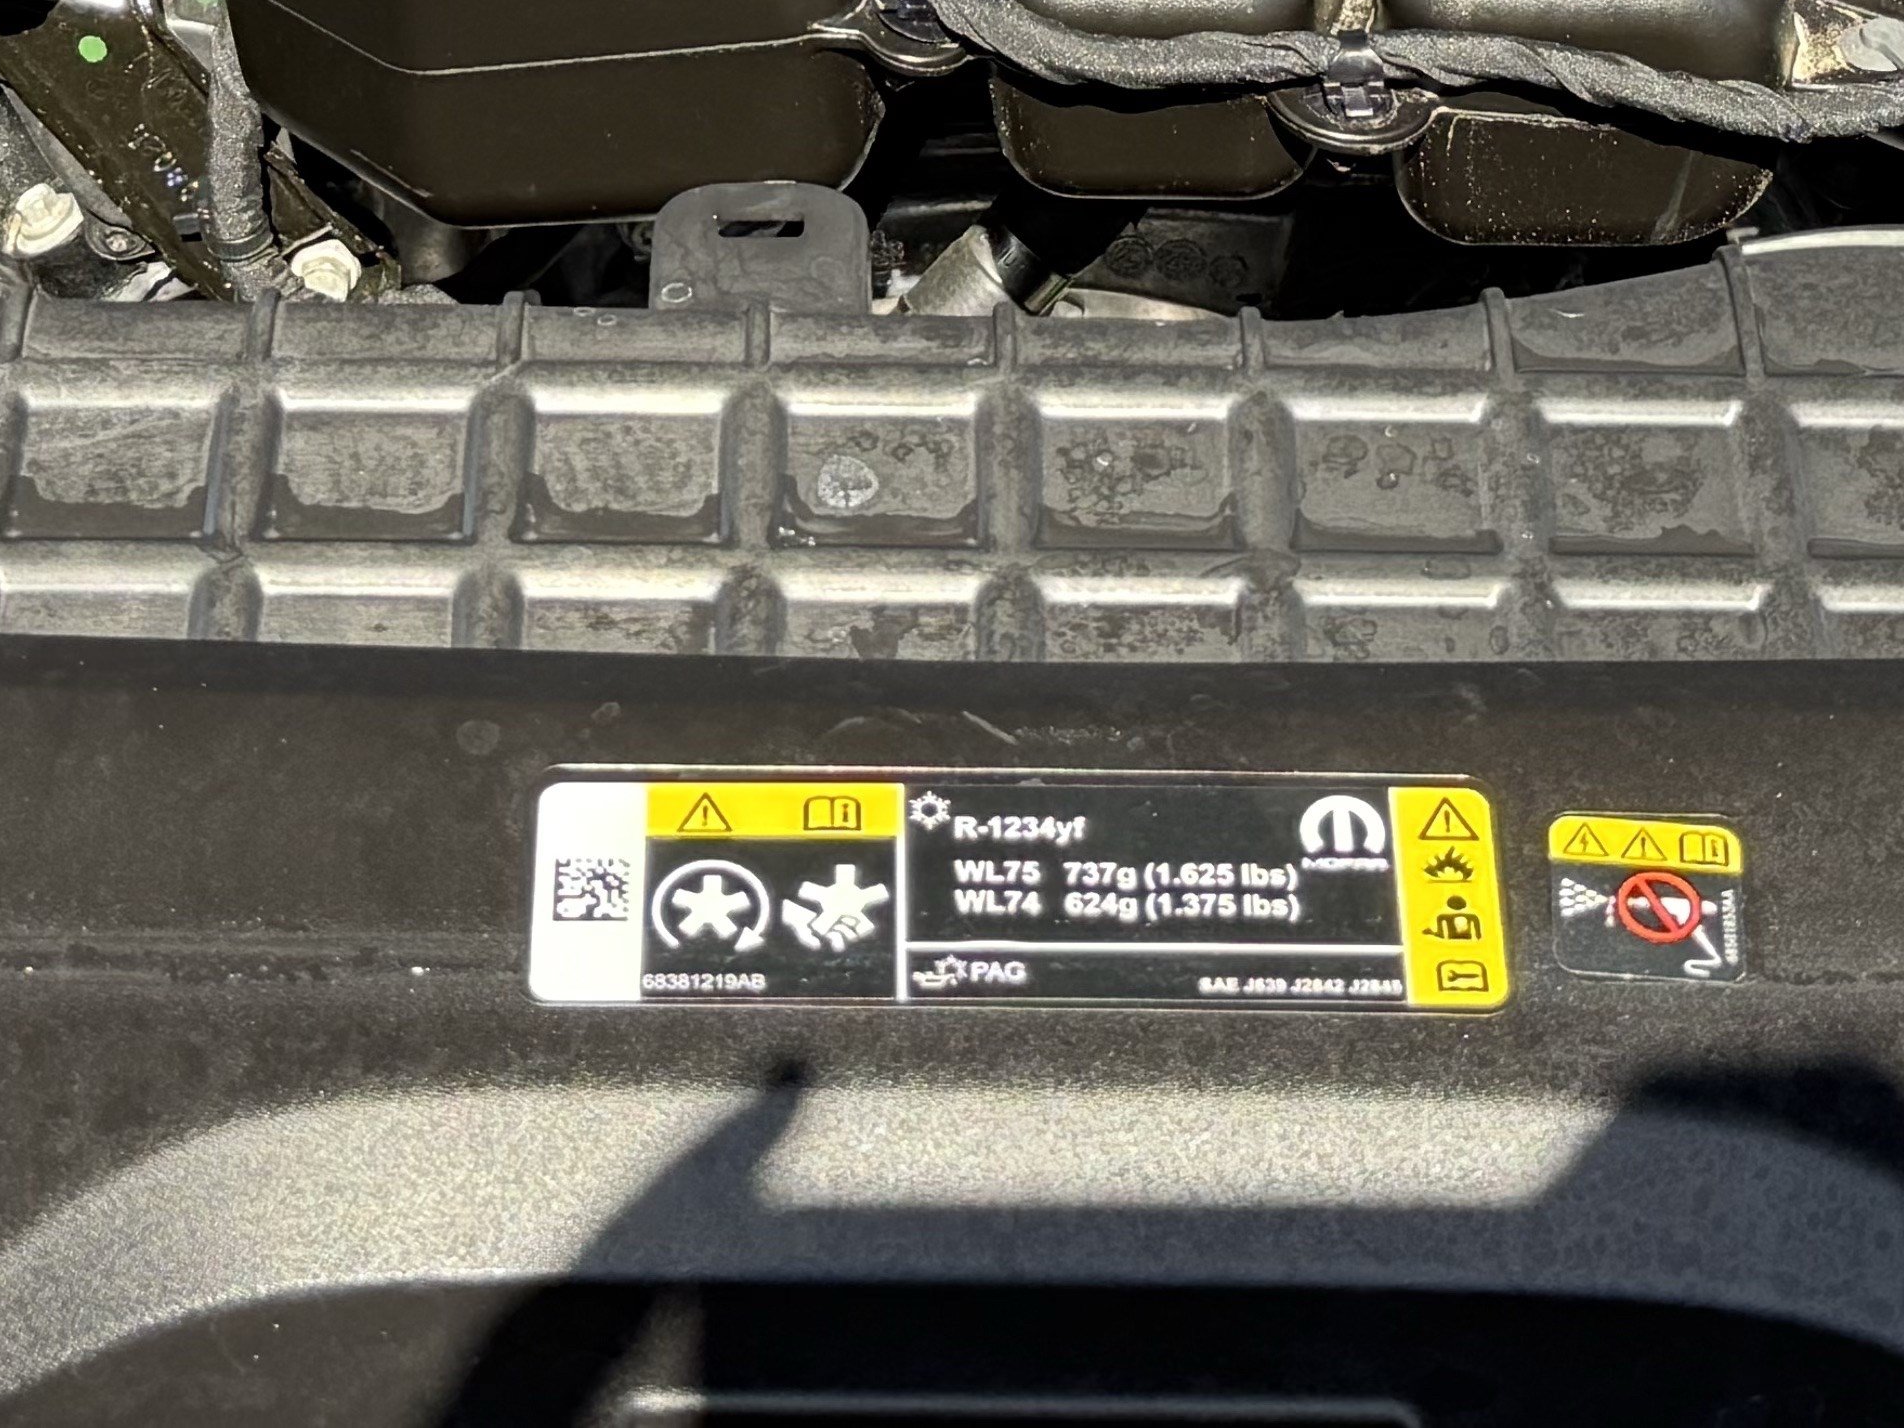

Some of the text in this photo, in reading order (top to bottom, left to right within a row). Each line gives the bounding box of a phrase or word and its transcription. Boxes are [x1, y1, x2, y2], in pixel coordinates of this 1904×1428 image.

[953, 815, 1087, 845] R-1234yf
[955, 859, 1298, 893] WL75 737g (1.625 lbs)
[956, 890, 1301, 924] WL74 624g (1.375 lbs)
[642, 972, 766, 991] 68381219AB
[973, 960, 1027, 983] PAG
[1198, 977, 1240, 995] SAE
